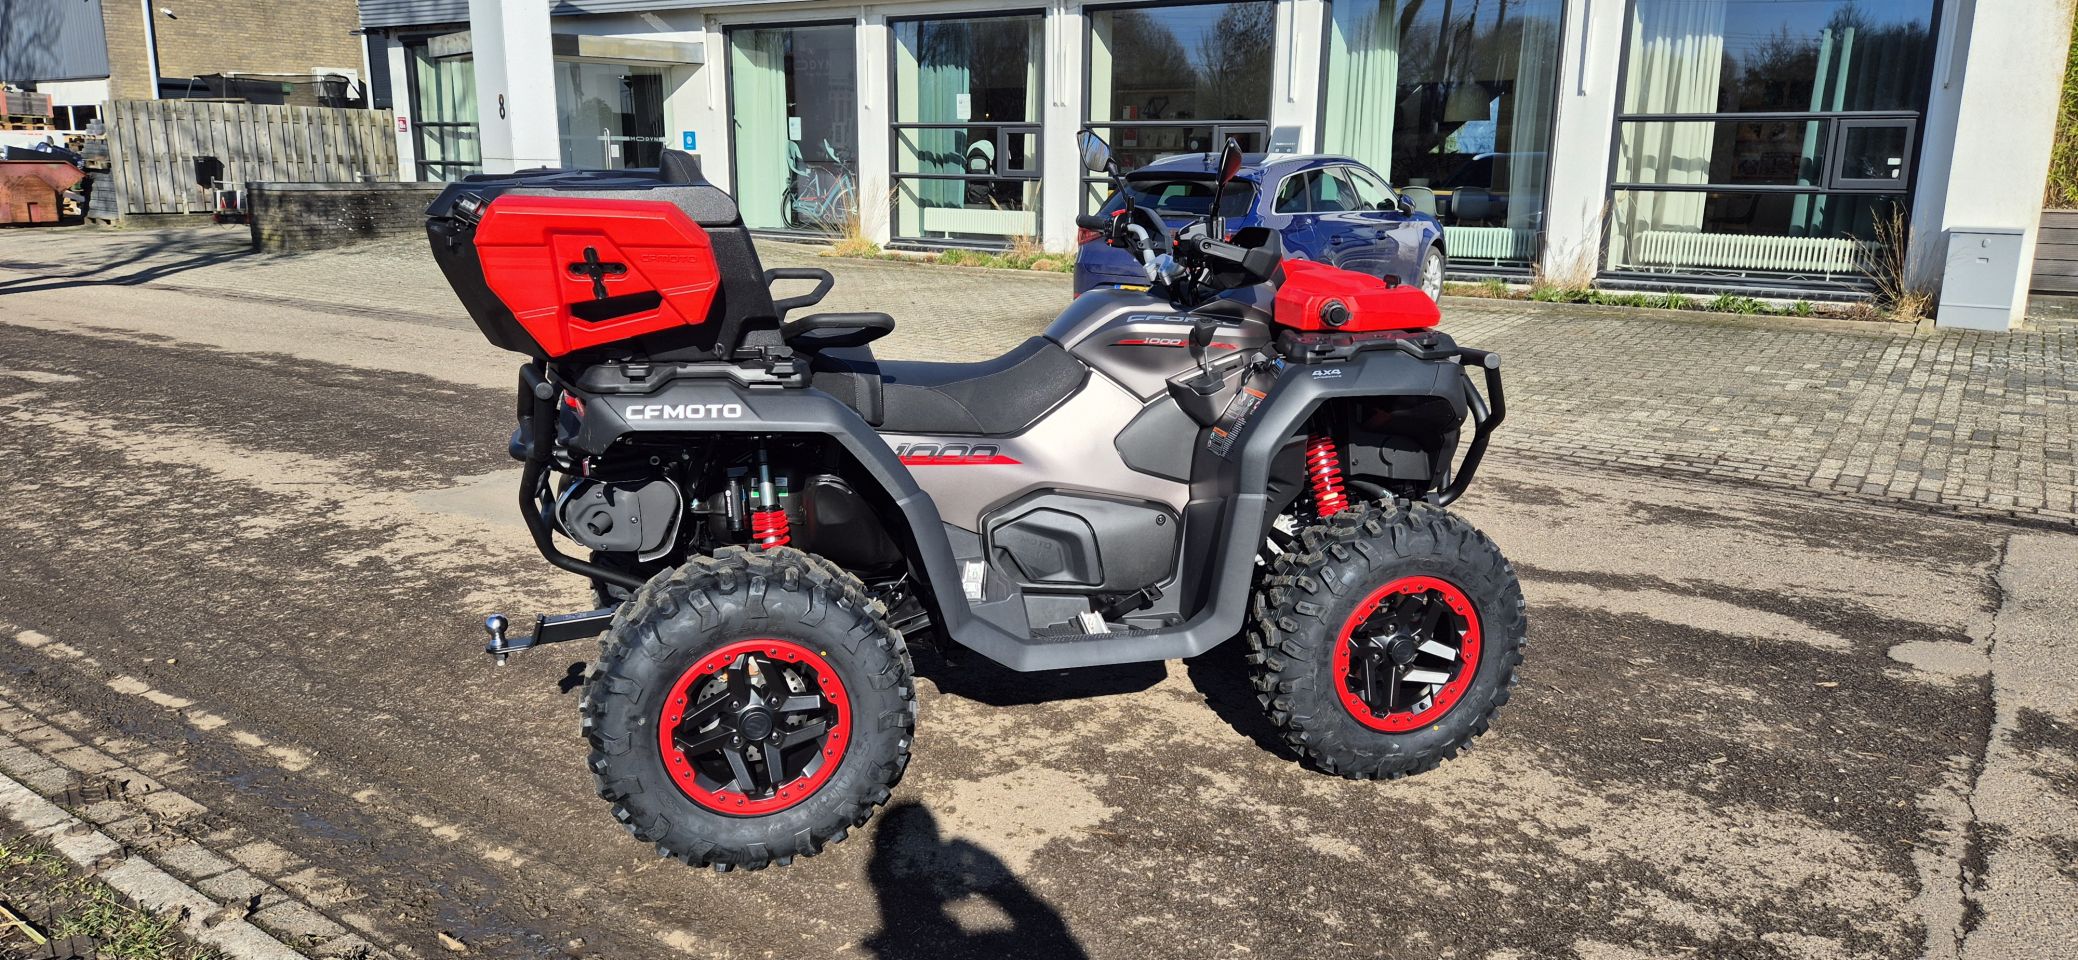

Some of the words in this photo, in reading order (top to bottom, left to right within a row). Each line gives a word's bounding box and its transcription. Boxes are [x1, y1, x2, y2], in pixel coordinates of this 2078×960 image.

[498, 94, 506, 120] 8
[1143, 337, 1182, 345] 1000
[625, 403, 742, 420] CFMOTO
[896, 442, 1001, 462] 1000
